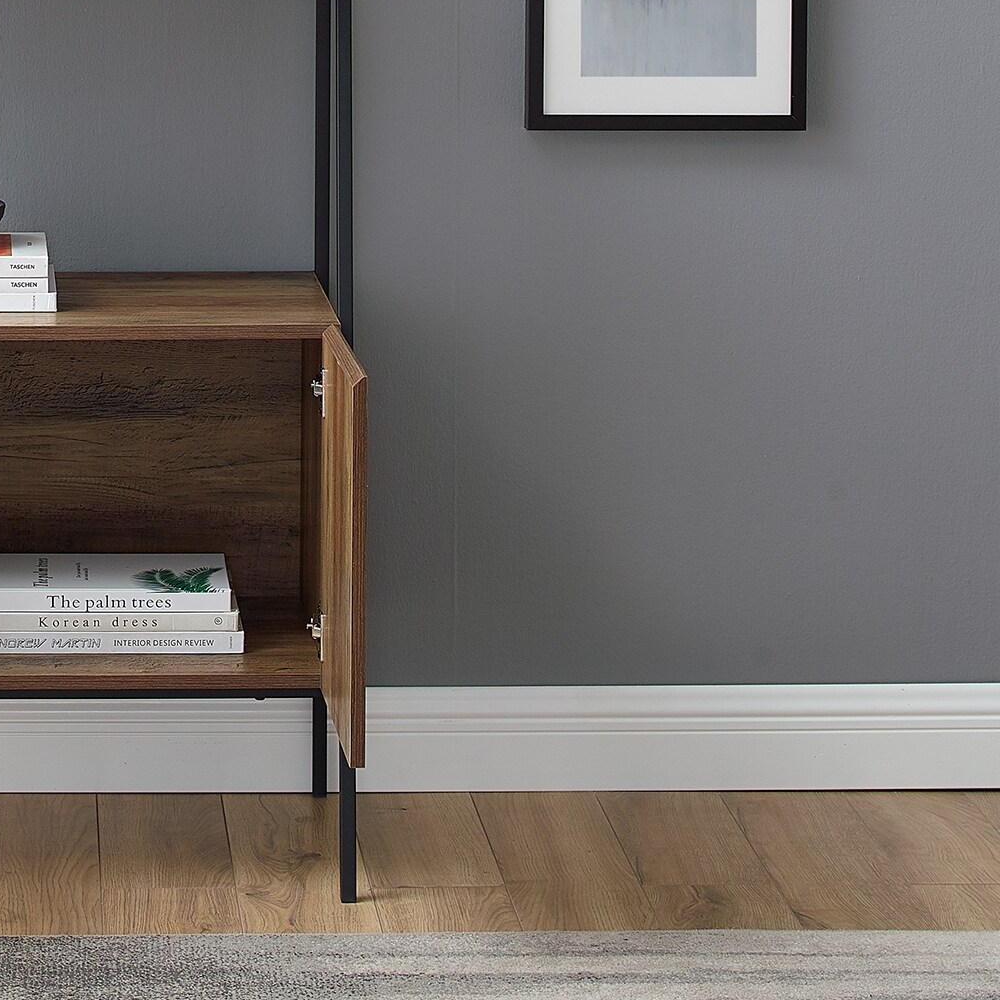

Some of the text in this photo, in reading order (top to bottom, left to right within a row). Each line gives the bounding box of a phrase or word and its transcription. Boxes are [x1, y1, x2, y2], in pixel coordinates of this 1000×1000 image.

[9, 263, 36, 271] TASCHEN
[10, 281, 38, 289] TASCHEN
[46, 595, 172, 612] The palm trees
[38, 616, 159, 628] Korean dress
[50, 638, 102, 649] MARTIN
[113, 639, 152, 648] INTERIOR
[152, 639, 183, 648] DESIGN
[184, 639, 215, 648] REVIEW
